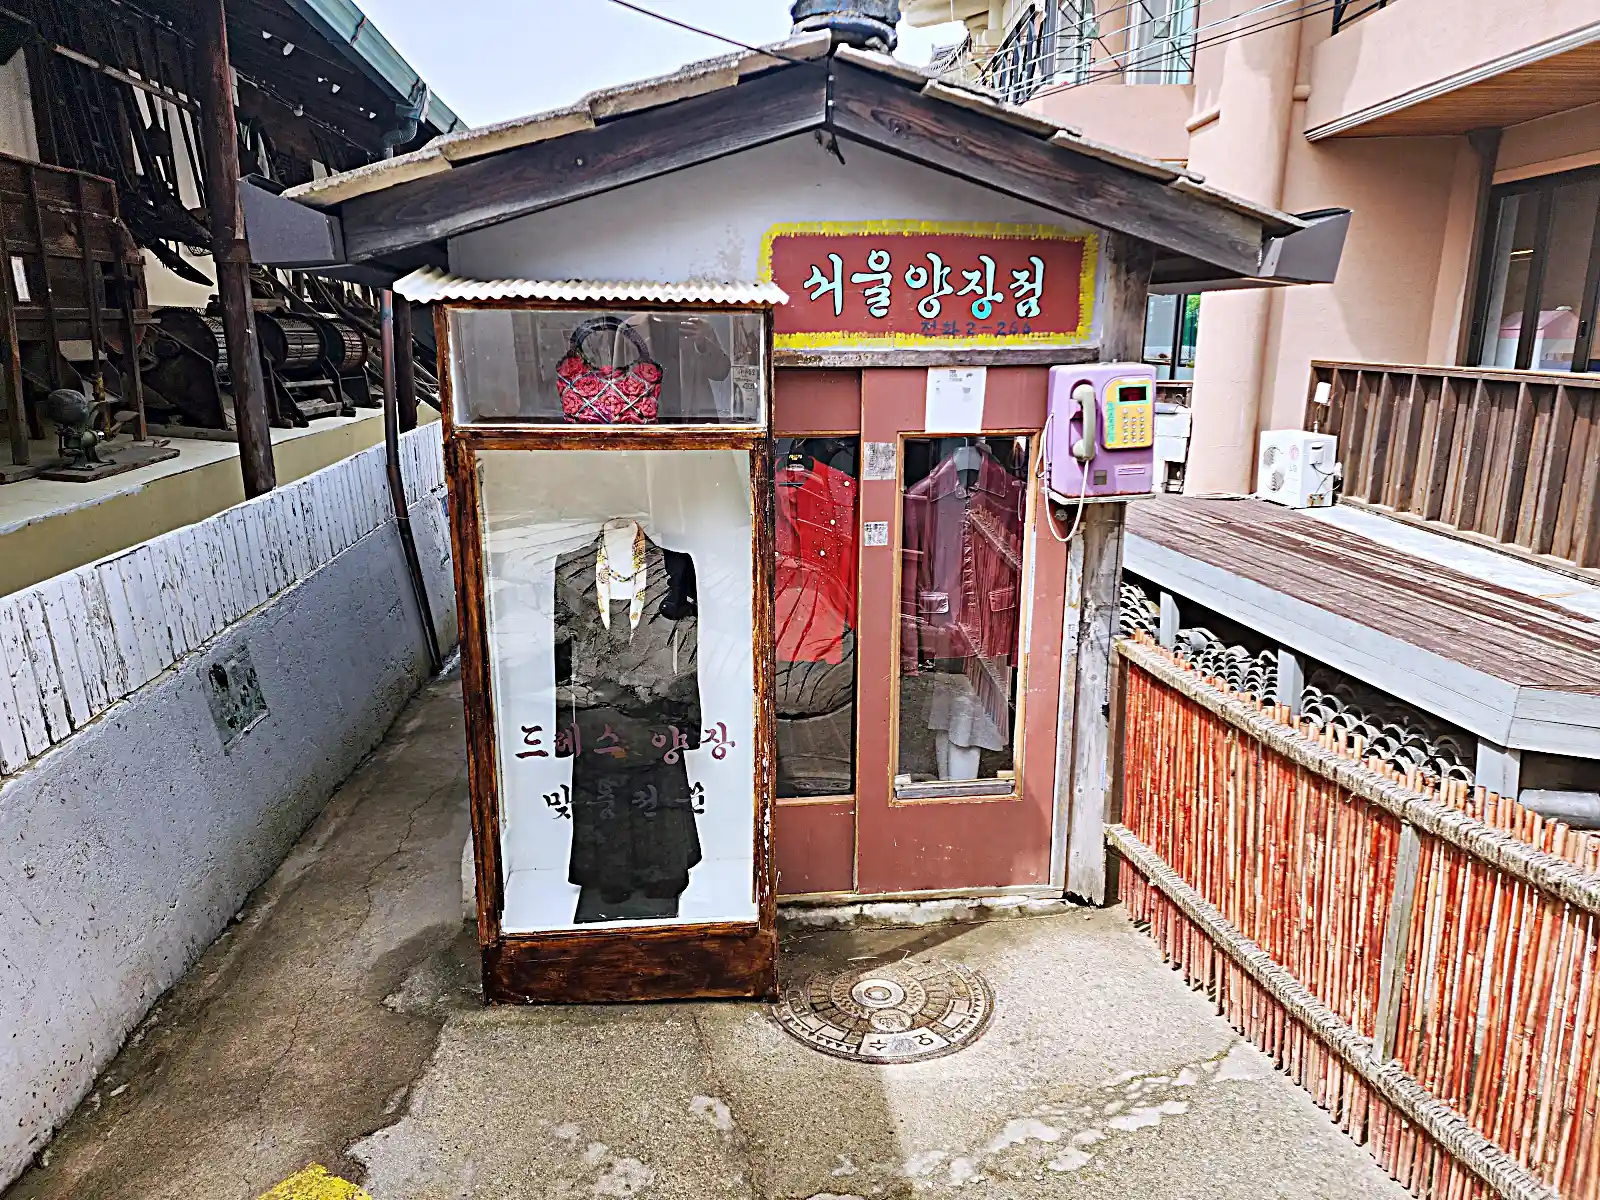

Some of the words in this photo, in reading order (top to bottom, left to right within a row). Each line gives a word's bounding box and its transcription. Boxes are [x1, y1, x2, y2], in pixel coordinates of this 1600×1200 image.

[803, 248, 1046, 320] 서울양장점
[515, 722, 629, 759] 드레스
[651, 722, 736, 765] 양장
